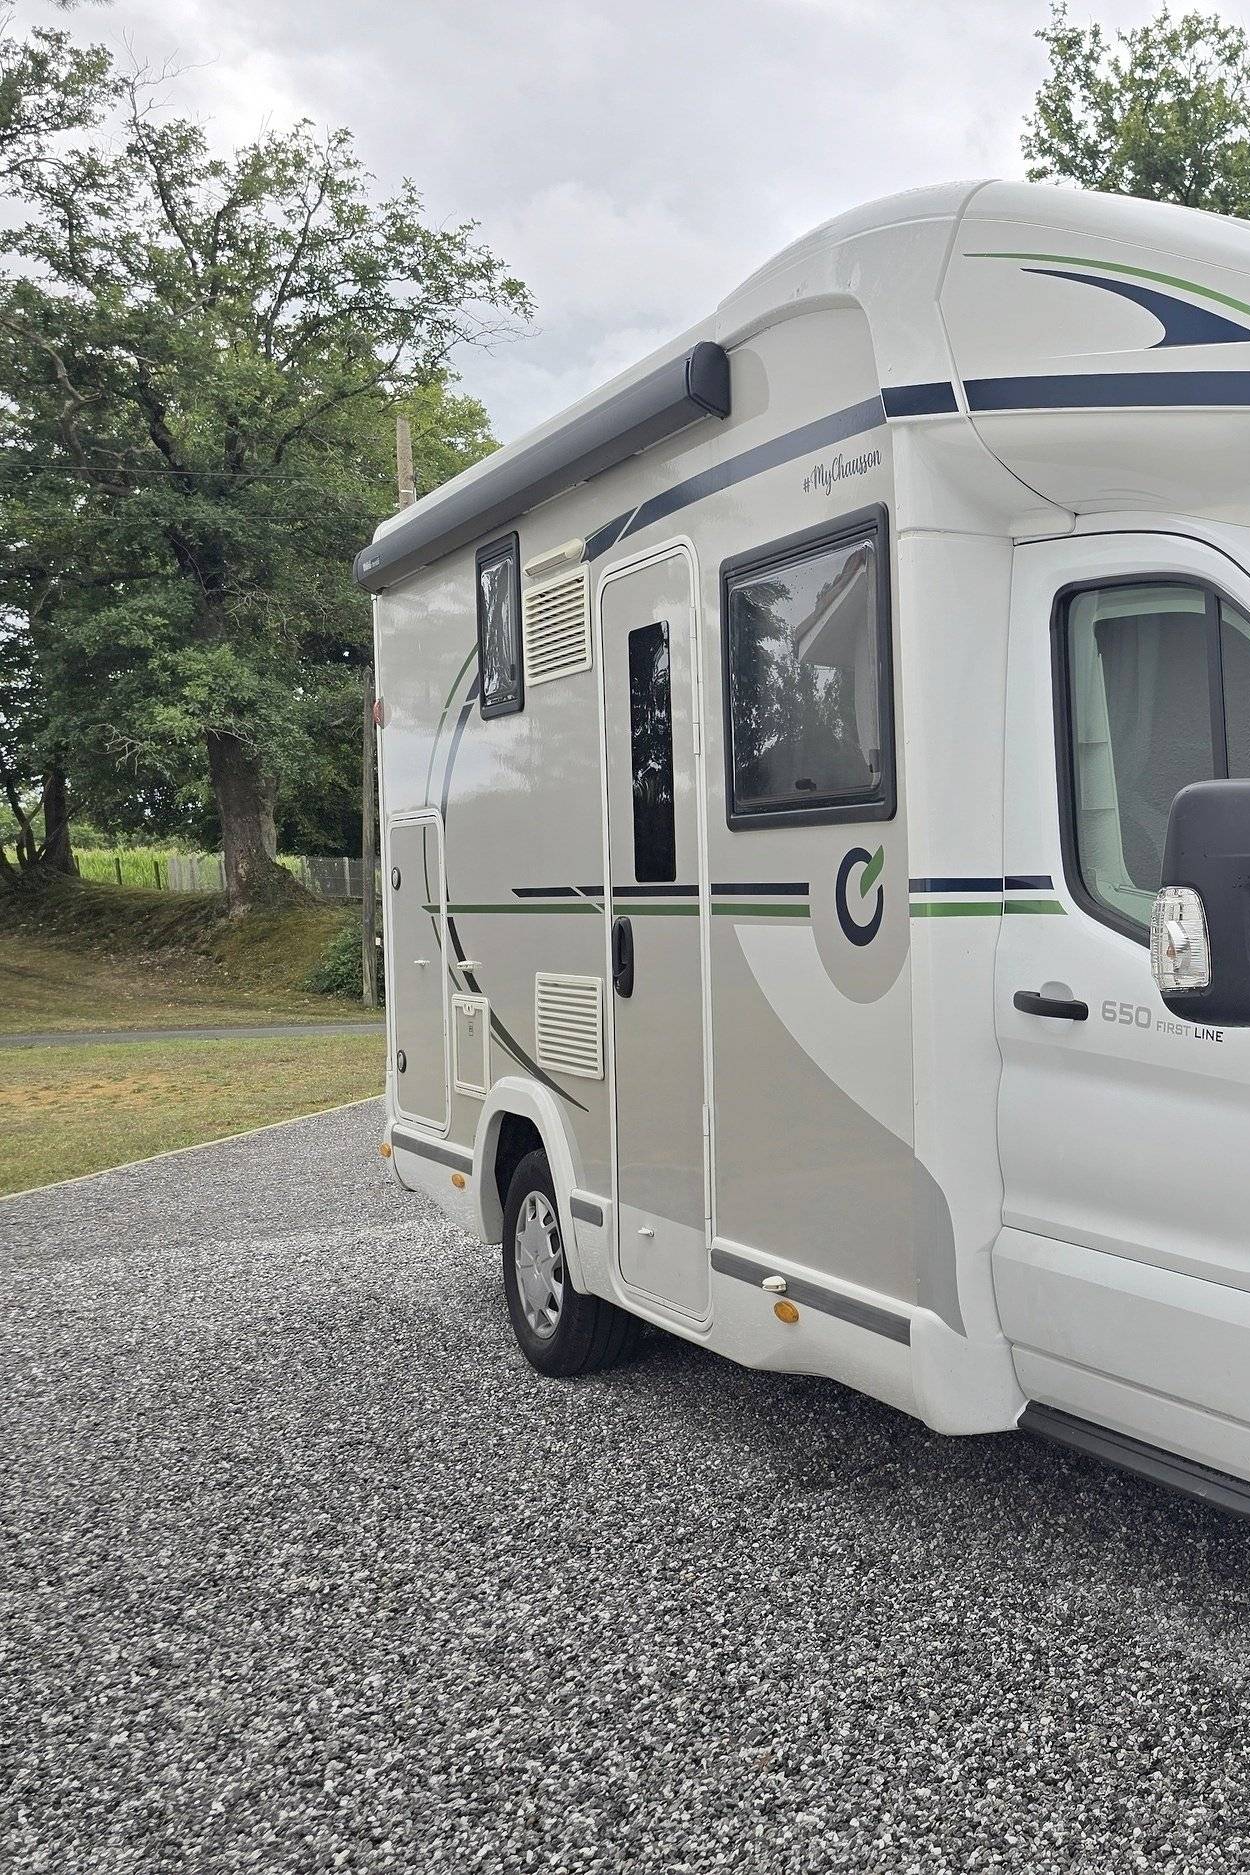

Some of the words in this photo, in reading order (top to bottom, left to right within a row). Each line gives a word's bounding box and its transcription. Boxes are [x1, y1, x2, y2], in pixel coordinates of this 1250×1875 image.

[802, 449, 882, 496] #MyChausson
[1101, 1000, 1152, 1029] 650
[1156, 1020, 1192, 1037] FIRST
[1194, 1027, 1224, 1043] LINE
